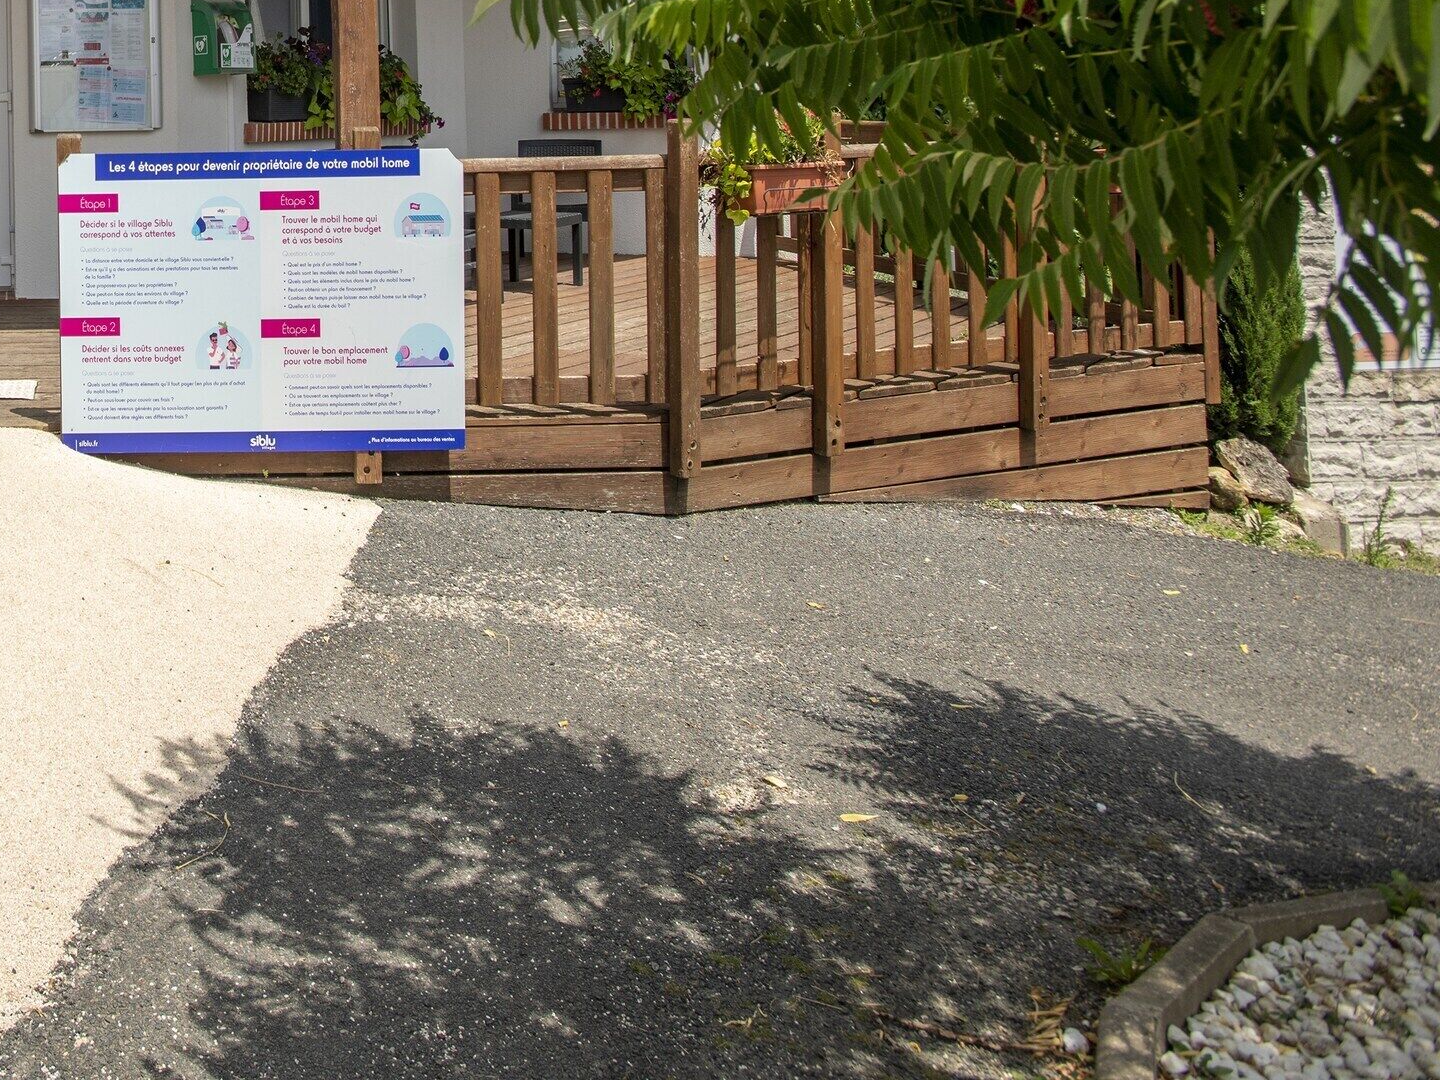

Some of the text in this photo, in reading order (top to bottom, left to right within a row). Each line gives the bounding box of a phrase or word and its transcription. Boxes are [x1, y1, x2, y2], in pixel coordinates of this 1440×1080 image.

[109, 157, 410, 175] Les 4 étapes pour devenir propriétaire de votre mobil home
[80, 197, 112, 211] Étape 1
[280, 194, 315, 208] Étape 3
[80, 219, 173, 230] Décider si le village Siblu
[282, 214, 378, 226] Trouver le mobil home qui
[80, 229, 120, 240] correspond
[122, 229, 128, 238] à
[144, 229, 176, 238] attentes
[282, 224, 382, 236] correspond à votre budget
[282, 235, 290, 244] et
[292, 235, 297, 244] à
[313, 235, 343, 244] besoins
[82, 320, 116, 335] Étape 2
[281, 322, 316, 336] Étape 4
[82, 344, 109, 353] Décider
[111, 344, 117, 353] si
[119, 344, 130, 353] les
[132, 344, 152, 353] coûts
[284, 345, 388, 357] Trouver le bon emplacement
[82, 354, 182, 365] rentrent dans votre budget
[284, 356, 367, 367] pour votre mobil home
[250, 435, 276, 447] siblu
